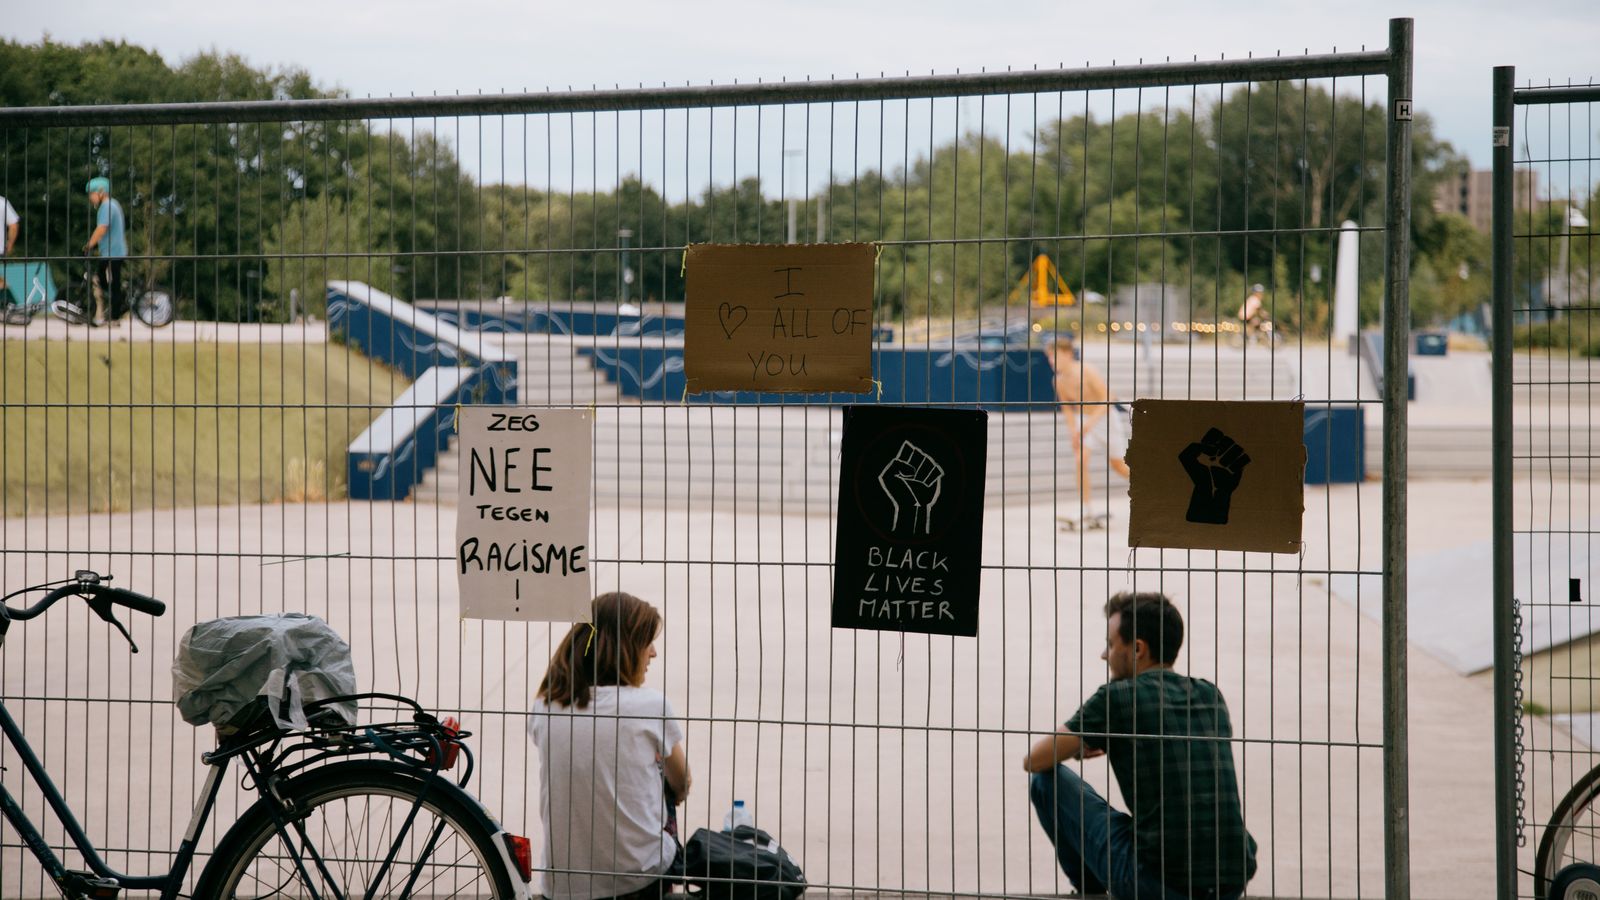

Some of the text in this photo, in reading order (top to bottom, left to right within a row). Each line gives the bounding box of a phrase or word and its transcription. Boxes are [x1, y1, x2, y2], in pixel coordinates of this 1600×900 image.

[774, 267, 804, 299] I
[772, 307, 867, 339] ALL OF
[748, 351, 808, 381] YOU
[487, 413, 540, 432] ZEG
[469, 446, 553, 496] NEE
[476, 504, 549, 523] TEGEN
[867, 546, 949, 572] BLACK
[515, 578, 520, 613] !
[864, 572, 944, 596] LIVES
[858, 598, 955, 621] MATTER
